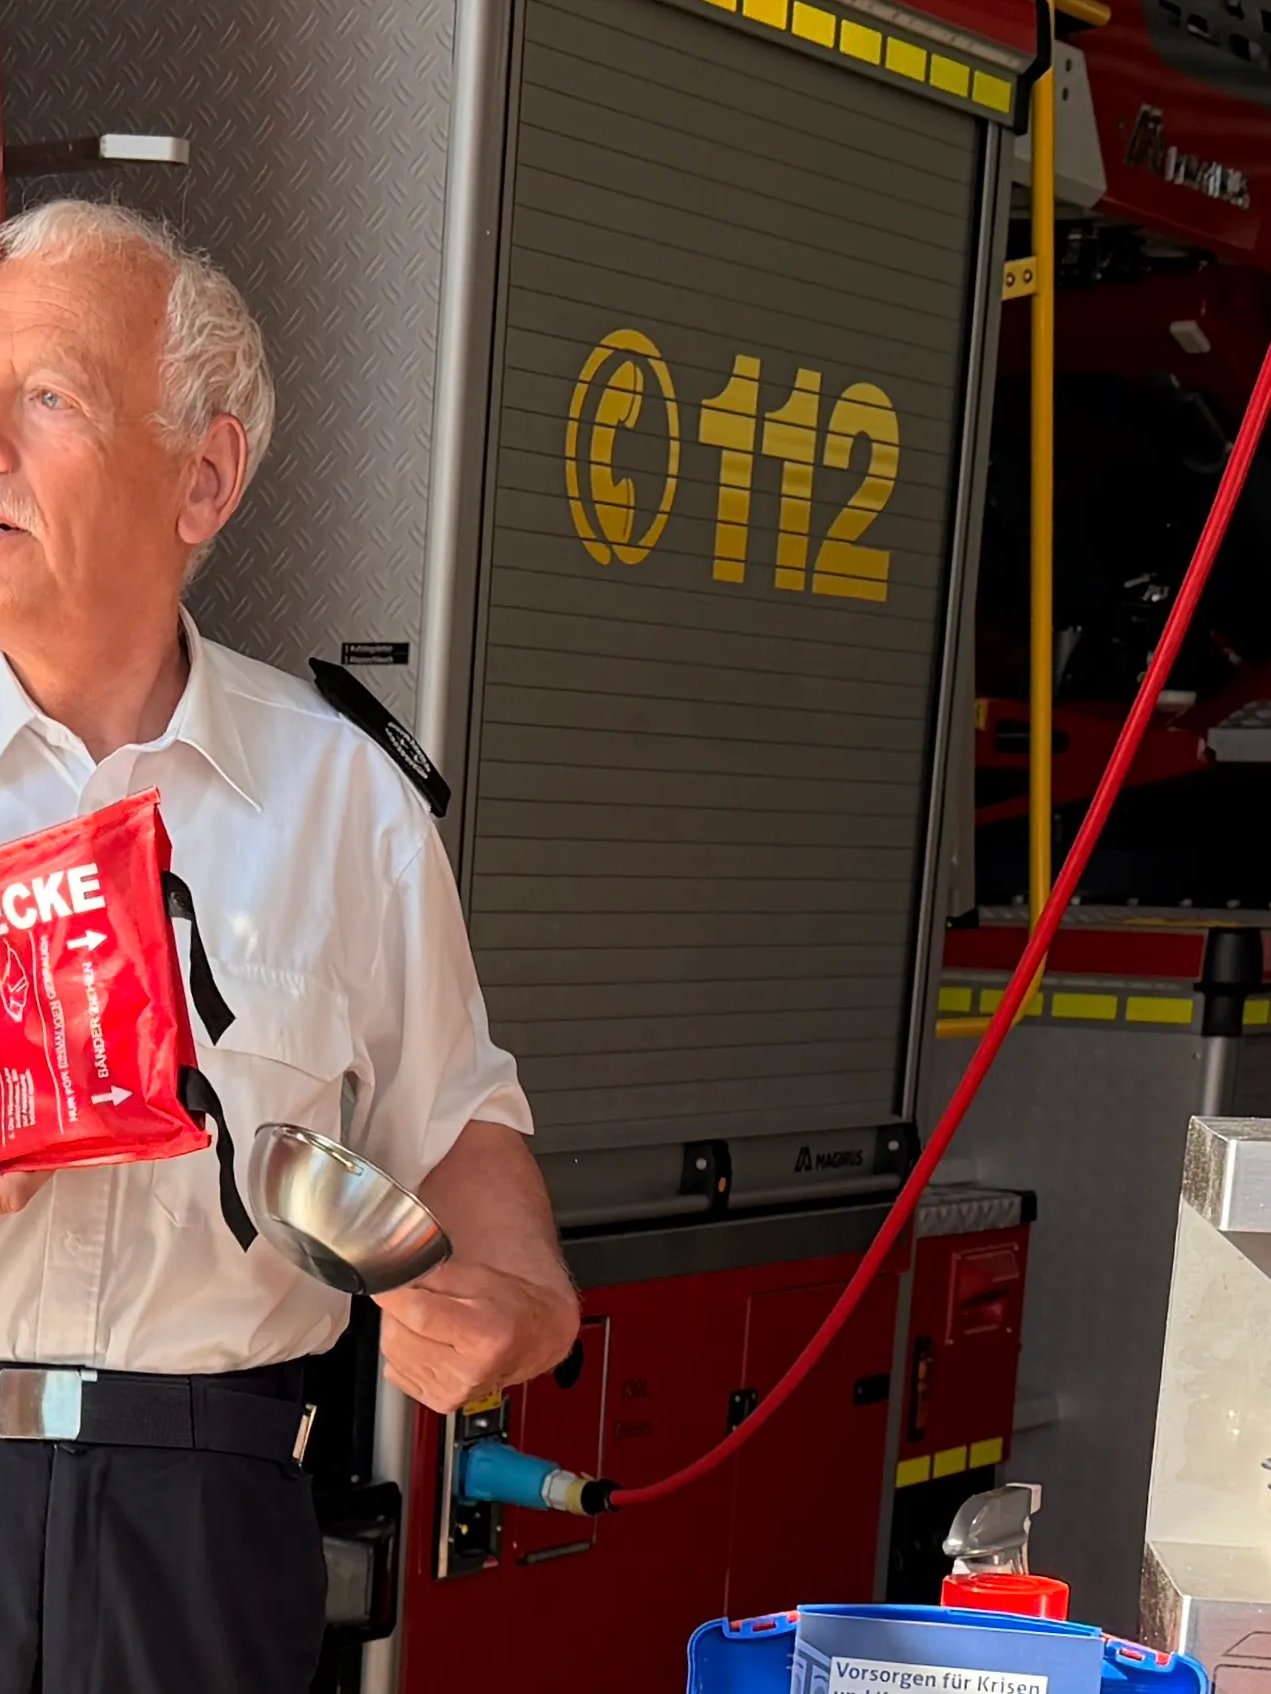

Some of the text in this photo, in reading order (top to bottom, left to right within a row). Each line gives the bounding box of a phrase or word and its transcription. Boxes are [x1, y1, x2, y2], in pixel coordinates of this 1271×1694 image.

[699, 354, 899, 601] 112
[90, 1015, 109, 1078] BÄNDER
[836, 1661, 1041, 1694] Vorsorgen für Krisen
